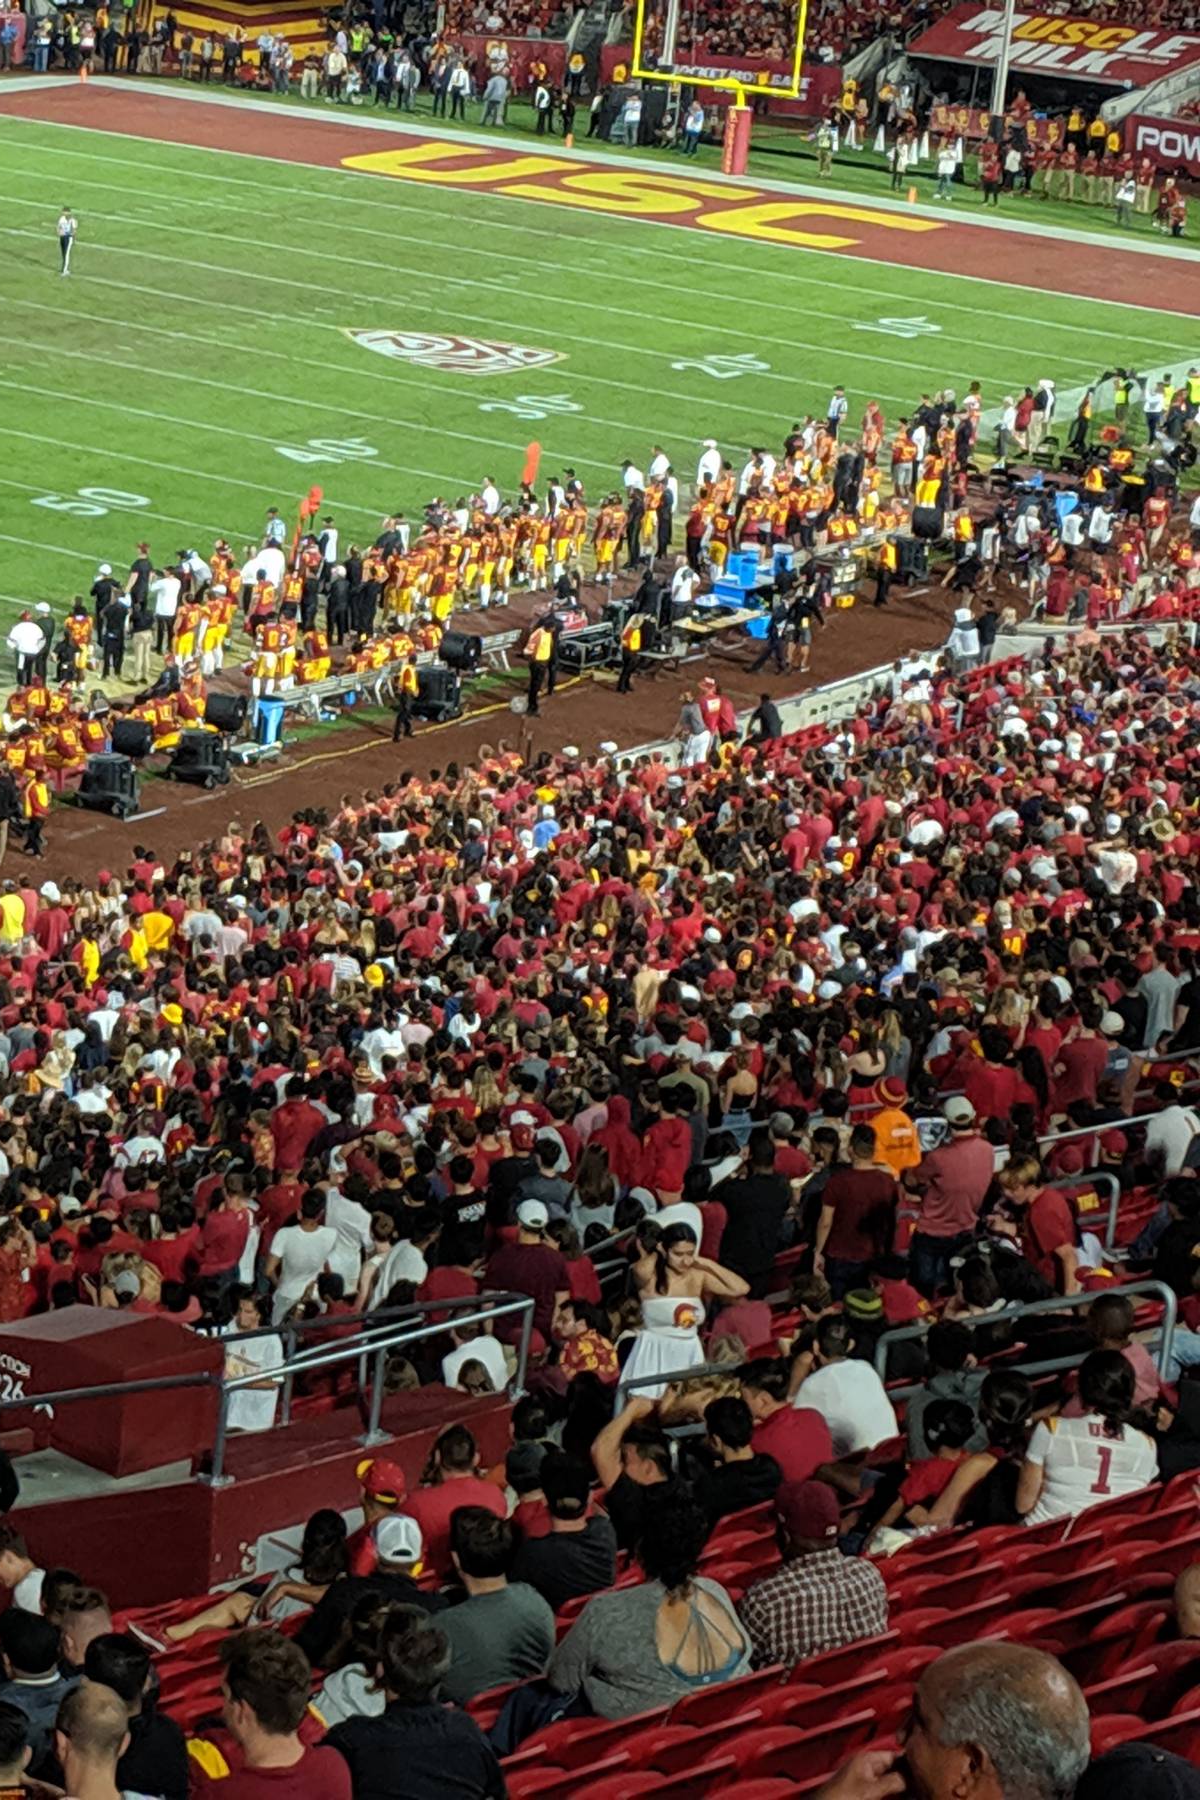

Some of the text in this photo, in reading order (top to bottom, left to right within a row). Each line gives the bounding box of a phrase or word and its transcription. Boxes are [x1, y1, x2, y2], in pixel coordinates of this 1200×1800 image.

[965, 37, 1127, 73] MILK
[341, 142, 947, 249] USC
[671, 353, 771, 379] 20
[478, 392, 584, 420] 30
[274, 437, 380, 464] 40
[30, 487, 152, 516] 50
[1090, 1446, 1112, 1494] 1
